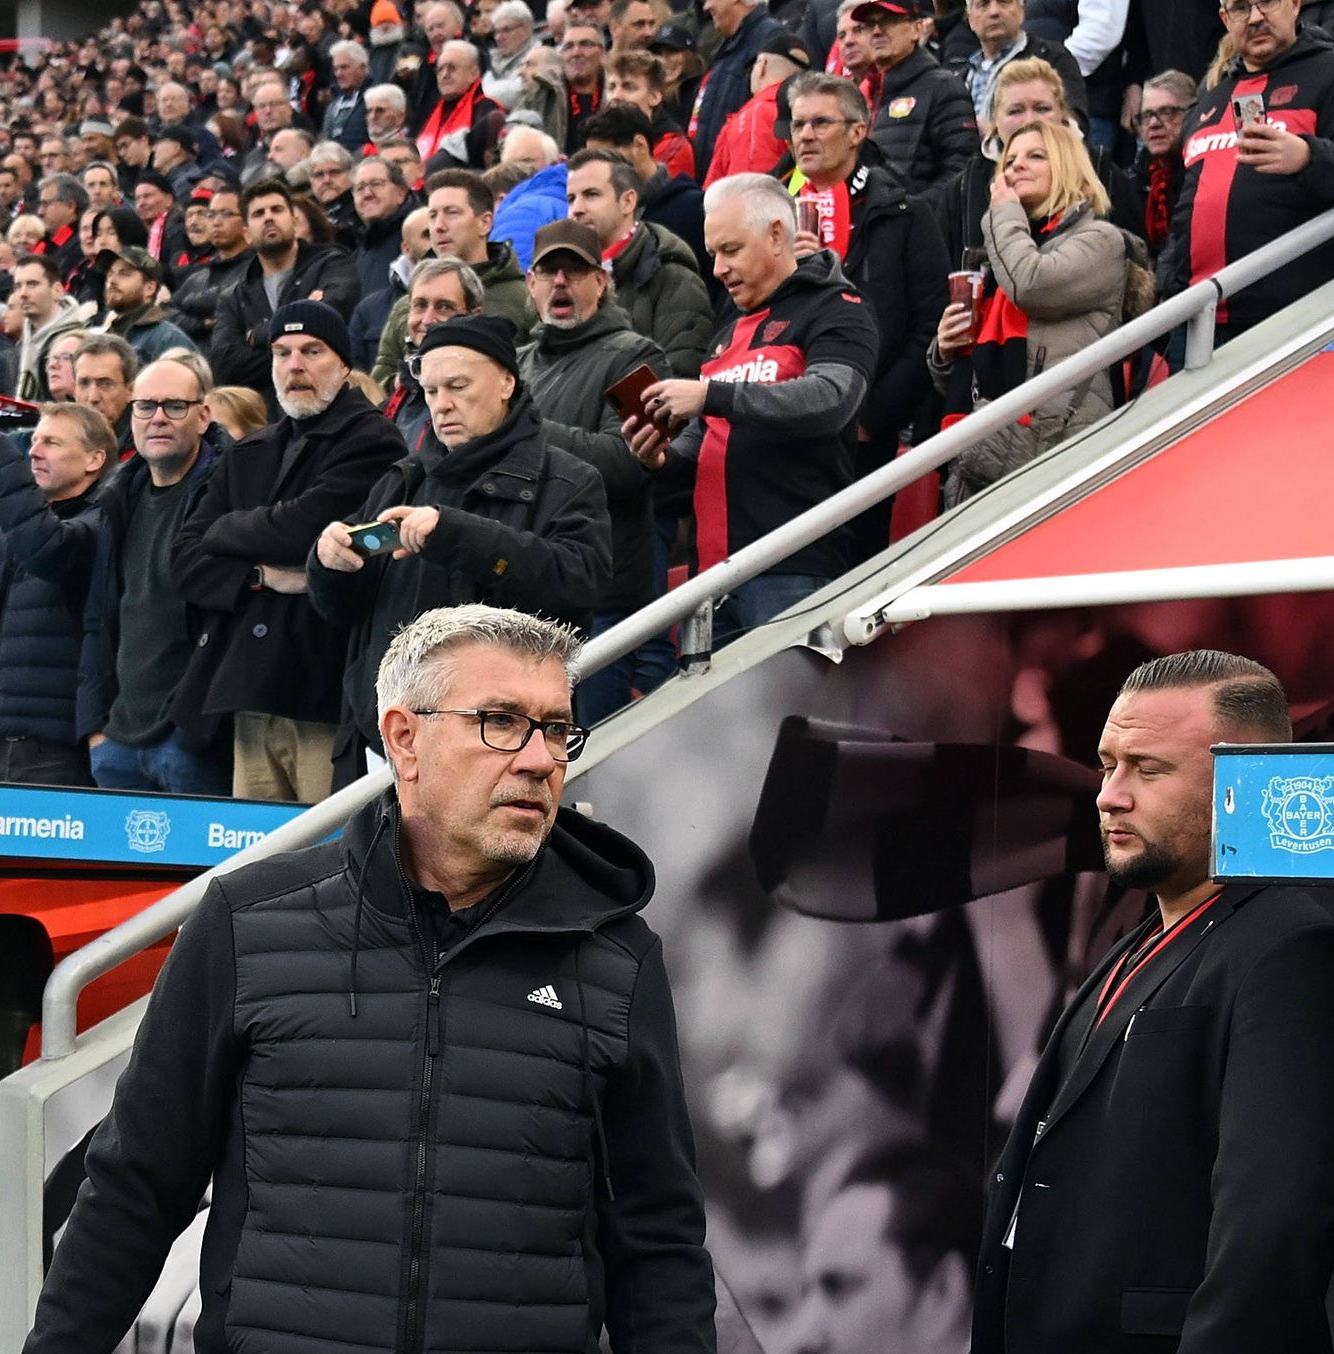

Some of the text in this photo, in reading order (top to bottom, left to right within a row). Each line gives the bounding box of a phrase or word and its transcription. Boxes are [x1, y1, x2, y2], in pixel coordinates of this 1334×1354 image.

[1293, 781, 1313, 789] 1904
[1286, 811, 1321, 820] BAYER
[208, 823, 266, 849] Barm
[1276, 836, 1332, 851] Leverkusen
[527, 993, 563, 1010] adidas
